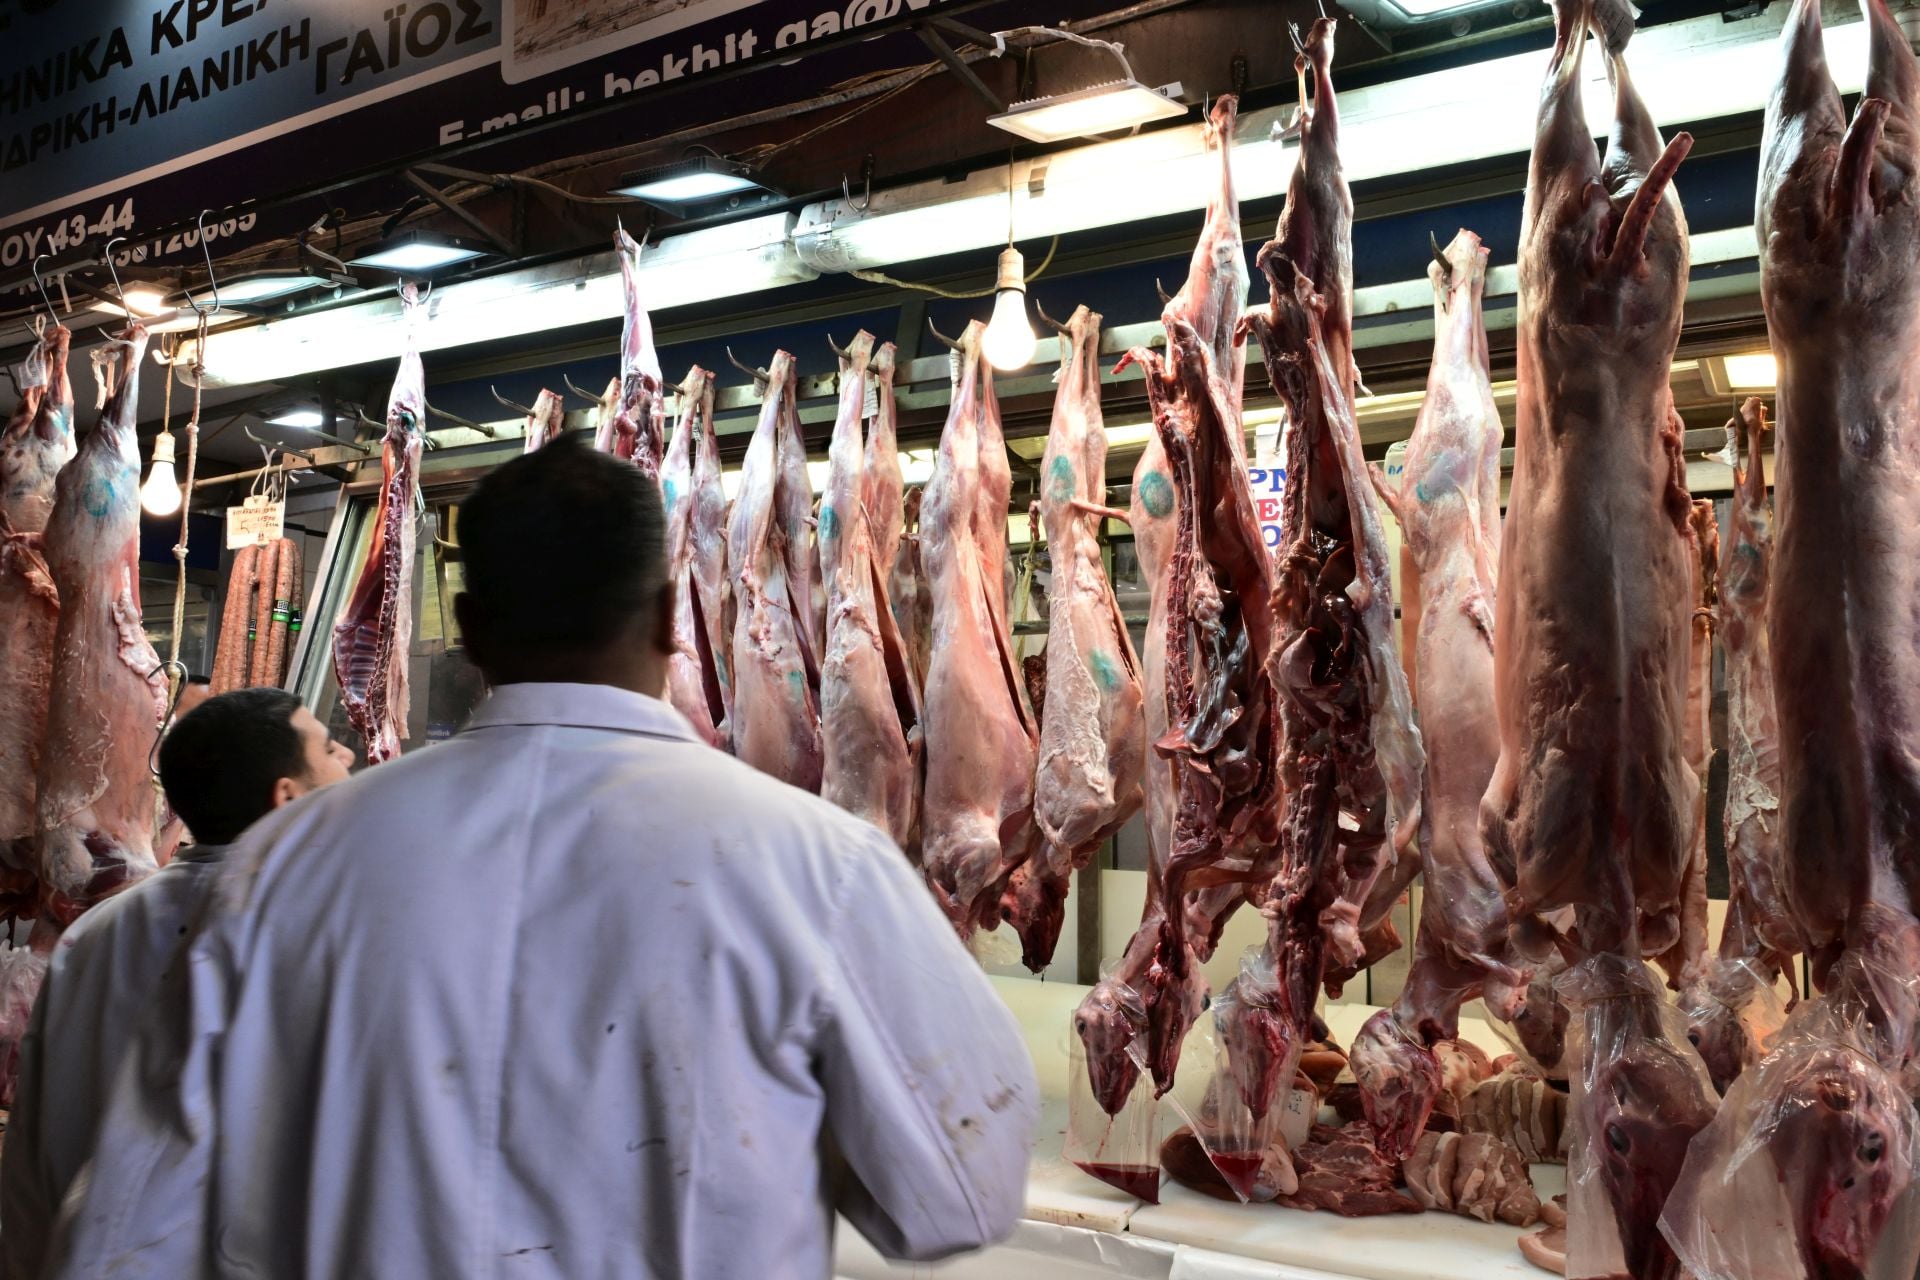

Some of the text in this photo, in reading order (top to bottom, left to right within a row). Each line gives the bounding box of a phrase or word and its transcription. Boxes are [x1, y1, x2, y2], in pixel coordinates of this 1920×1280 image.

[150, 0, 270, 56] ΚΡΕ
[0, 18, 311, 173] ΔΡΙΚΗ-ΛΙΑΝΙΚΗ
[0, 198, 136, 268] ΟΥ 43-44
